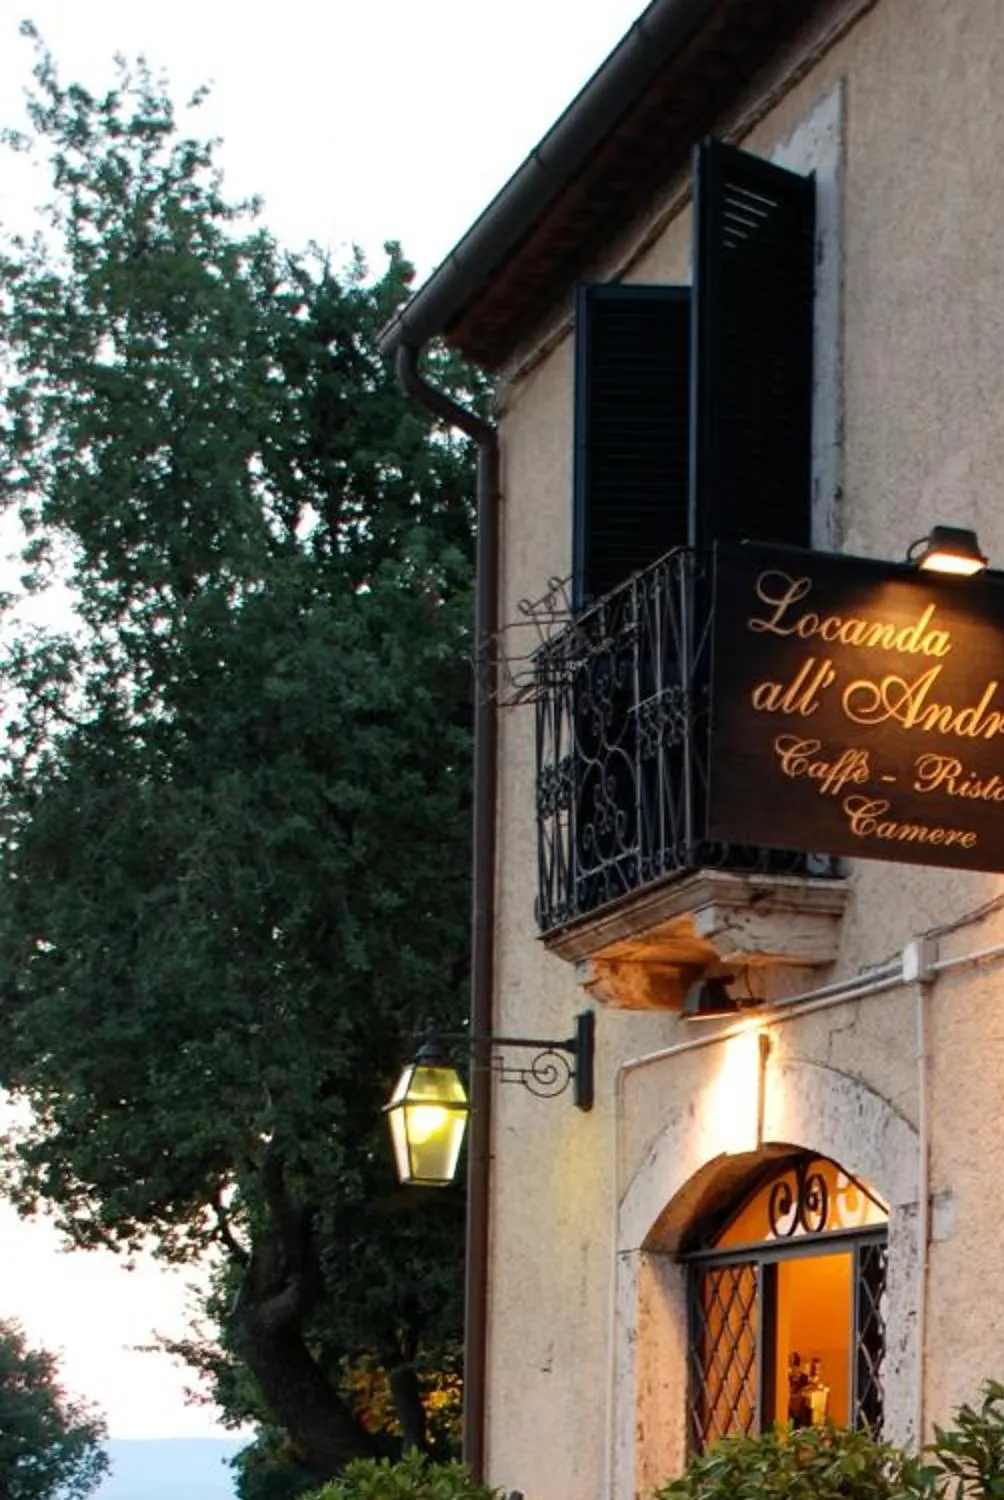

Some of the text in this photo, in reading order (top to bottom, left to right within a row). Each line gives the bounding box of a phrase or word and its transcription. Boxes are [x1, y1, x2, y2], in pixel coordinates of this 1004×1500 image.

[749, 570, 951, 657] Locanda
[775, 734, 870, 795] Caffè
[843, 796, 977, 849] Camere
